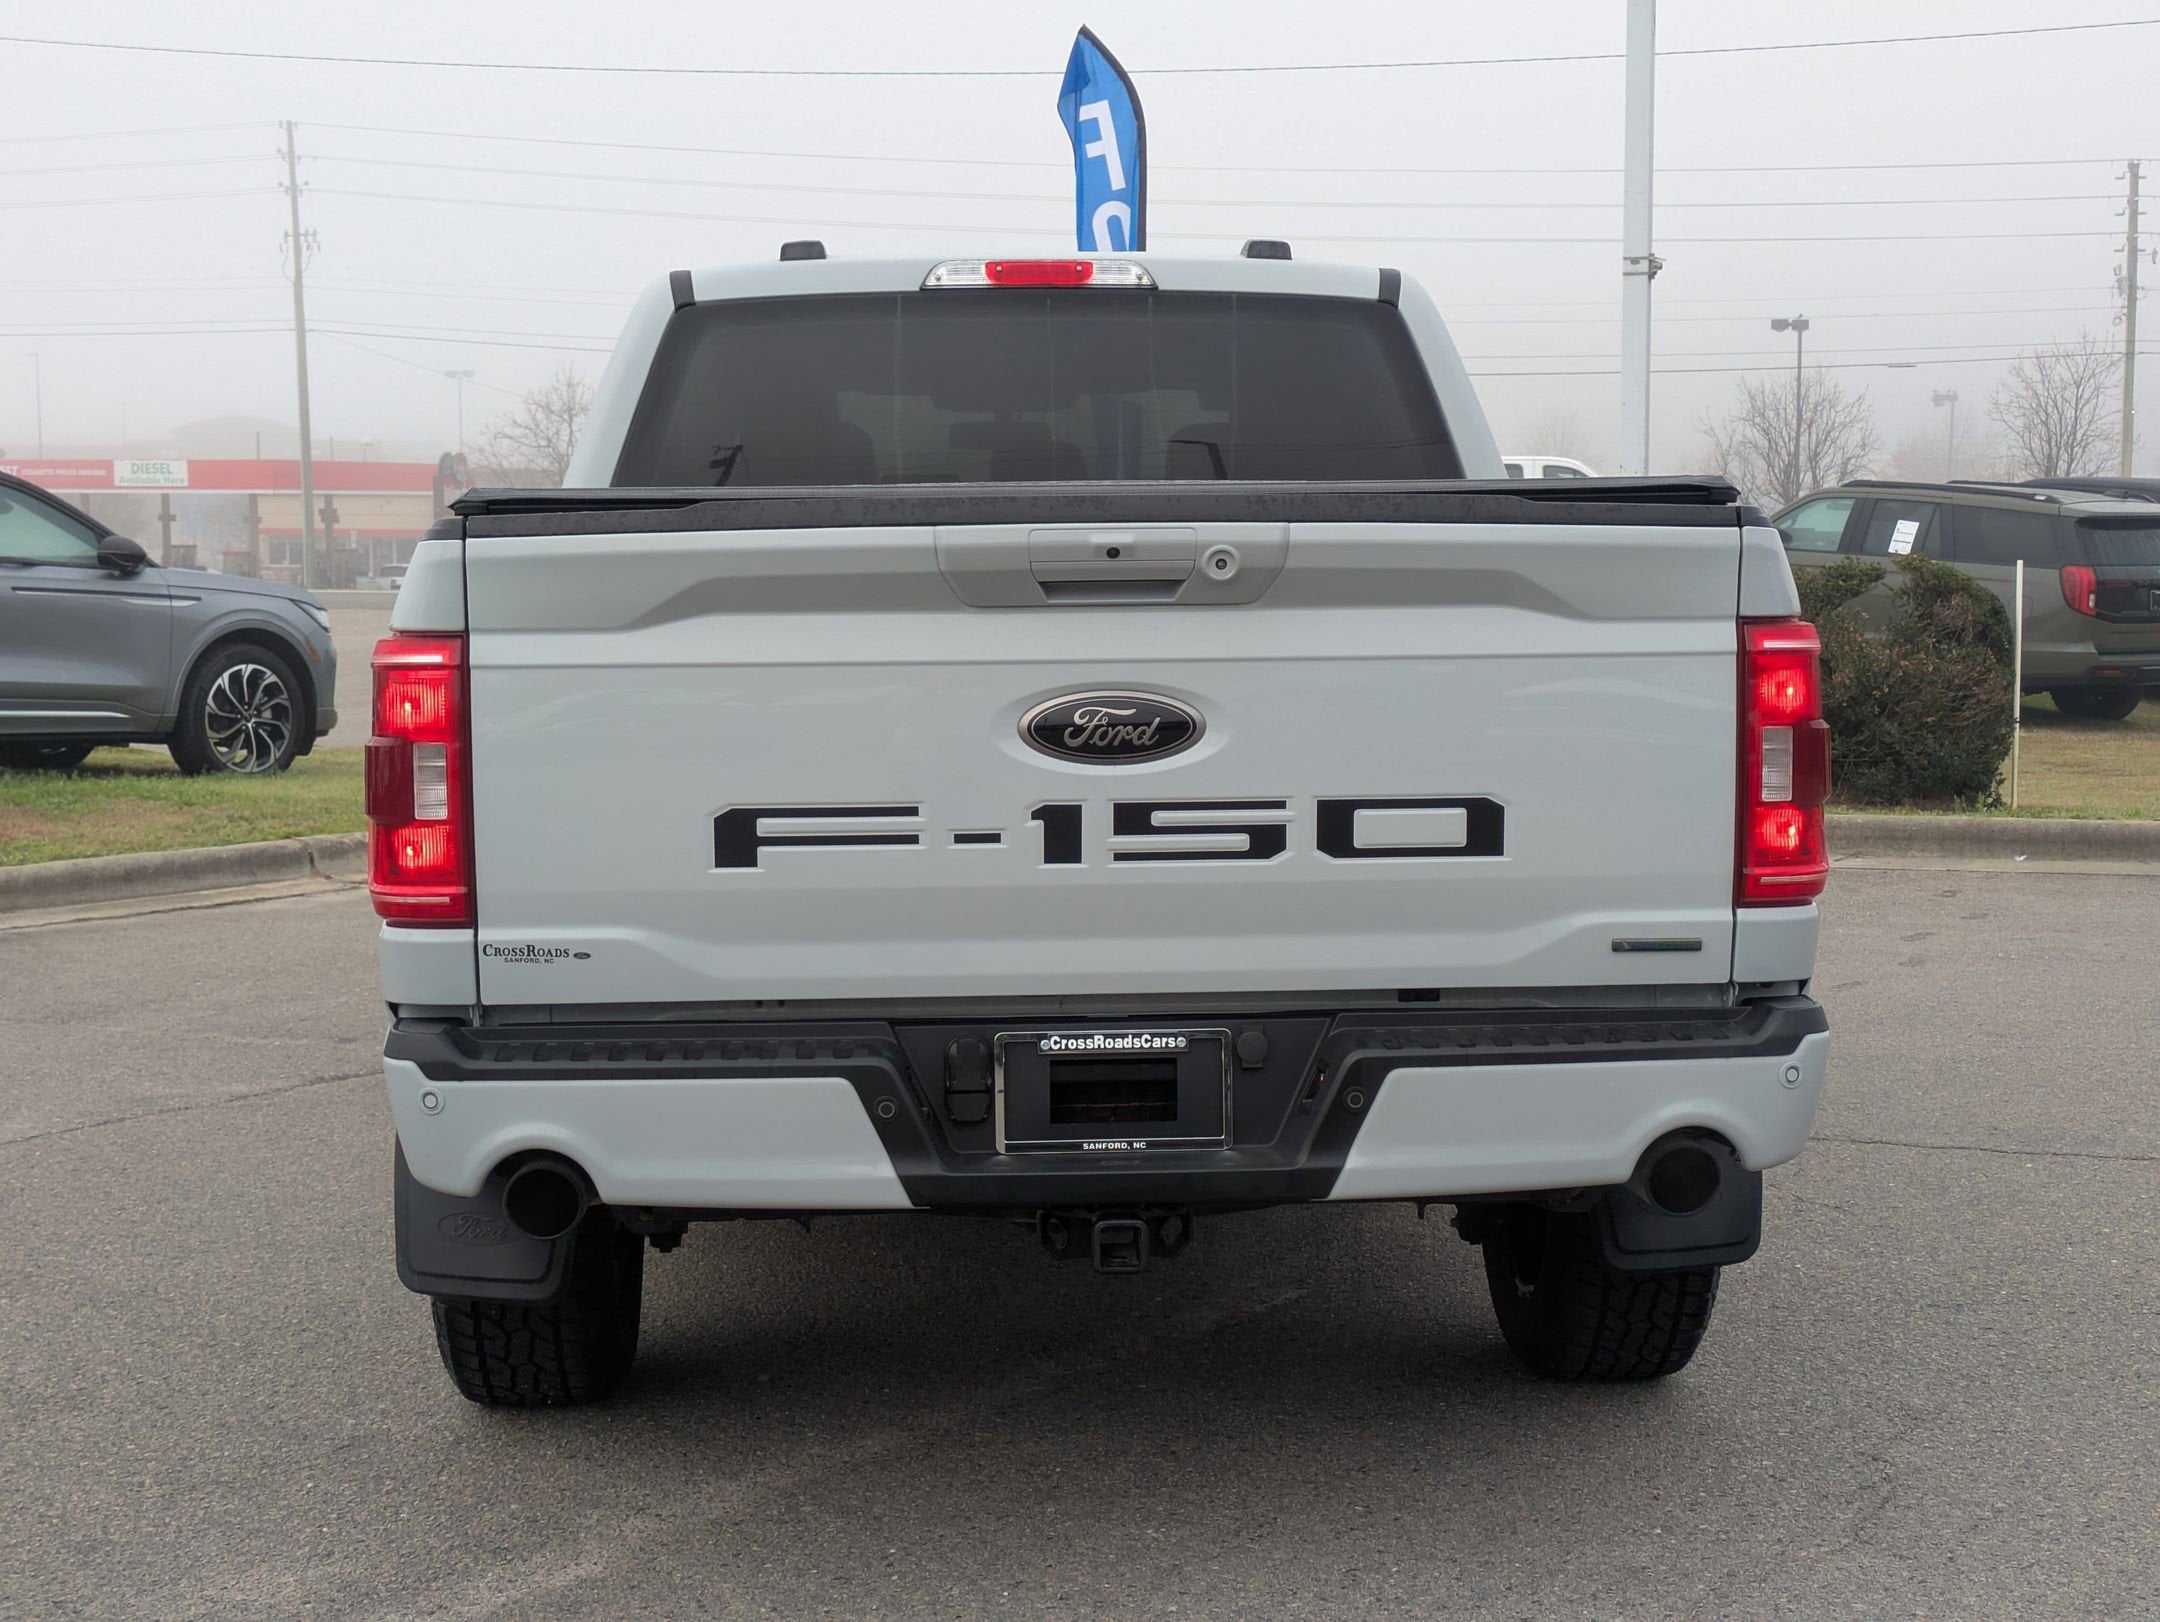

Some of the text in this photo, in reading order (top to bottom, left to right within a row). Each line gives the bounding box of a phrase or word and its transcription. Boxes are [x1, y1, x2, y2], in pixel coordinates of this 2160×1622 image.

[131, 462, 173, 475] DIESEL
[163, 475, 185, 485] Here
[1063, 706, 1161, 748] Ford
[712, 796, 1506, 868] F-150
[504, 957, 542, 965] SANFORD,
[1049, 1034, 1177, 1050] CrossRoadsCars
[1082, 1141, 1147, 1150] SANFORD, NC
[451, 1214, 511, 1239] Ford
